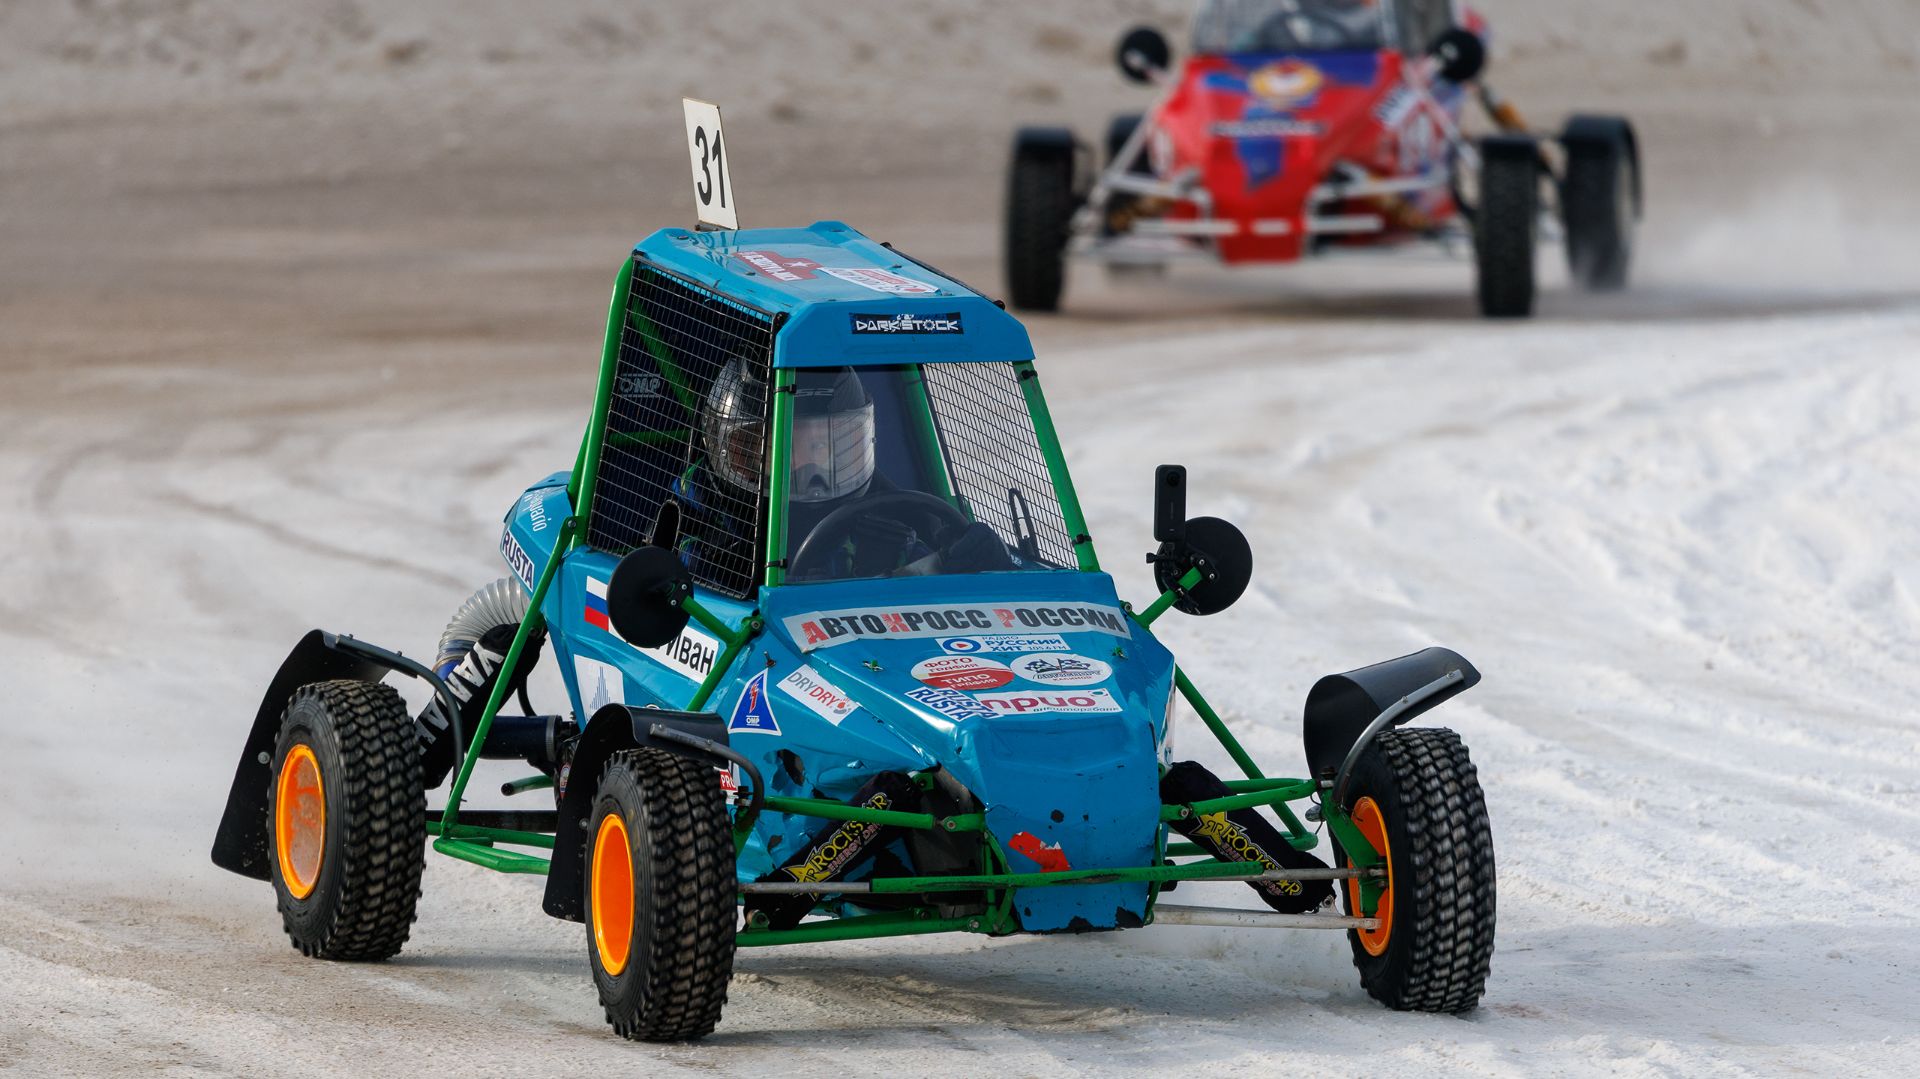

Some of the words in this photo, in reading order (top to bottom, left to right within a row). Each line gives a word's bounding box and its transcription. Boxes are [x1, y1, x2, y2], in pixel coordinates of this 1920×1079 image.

[695, 125, 726, 208] 31
[502, 531, 534, 589] RUSTA
[801, 609, 992, 645] АВТОКРОСС
[992, 607, 1127, 634] РОССИИ
[985, 638, 1062, 646] РУССКИЙ
[924, 657, 973, 668] ФОТО
[930, 663, 979, 673] ГРАФИЯ
[941, 673, 991, 684] ТИПО
[951, 678, 998, 689] ГРАФИЯ
[413, 641, 505, 756] YAMAH
[907, 688, 973, 721] RUSTA
[745, 717, 760, 725] OMP
